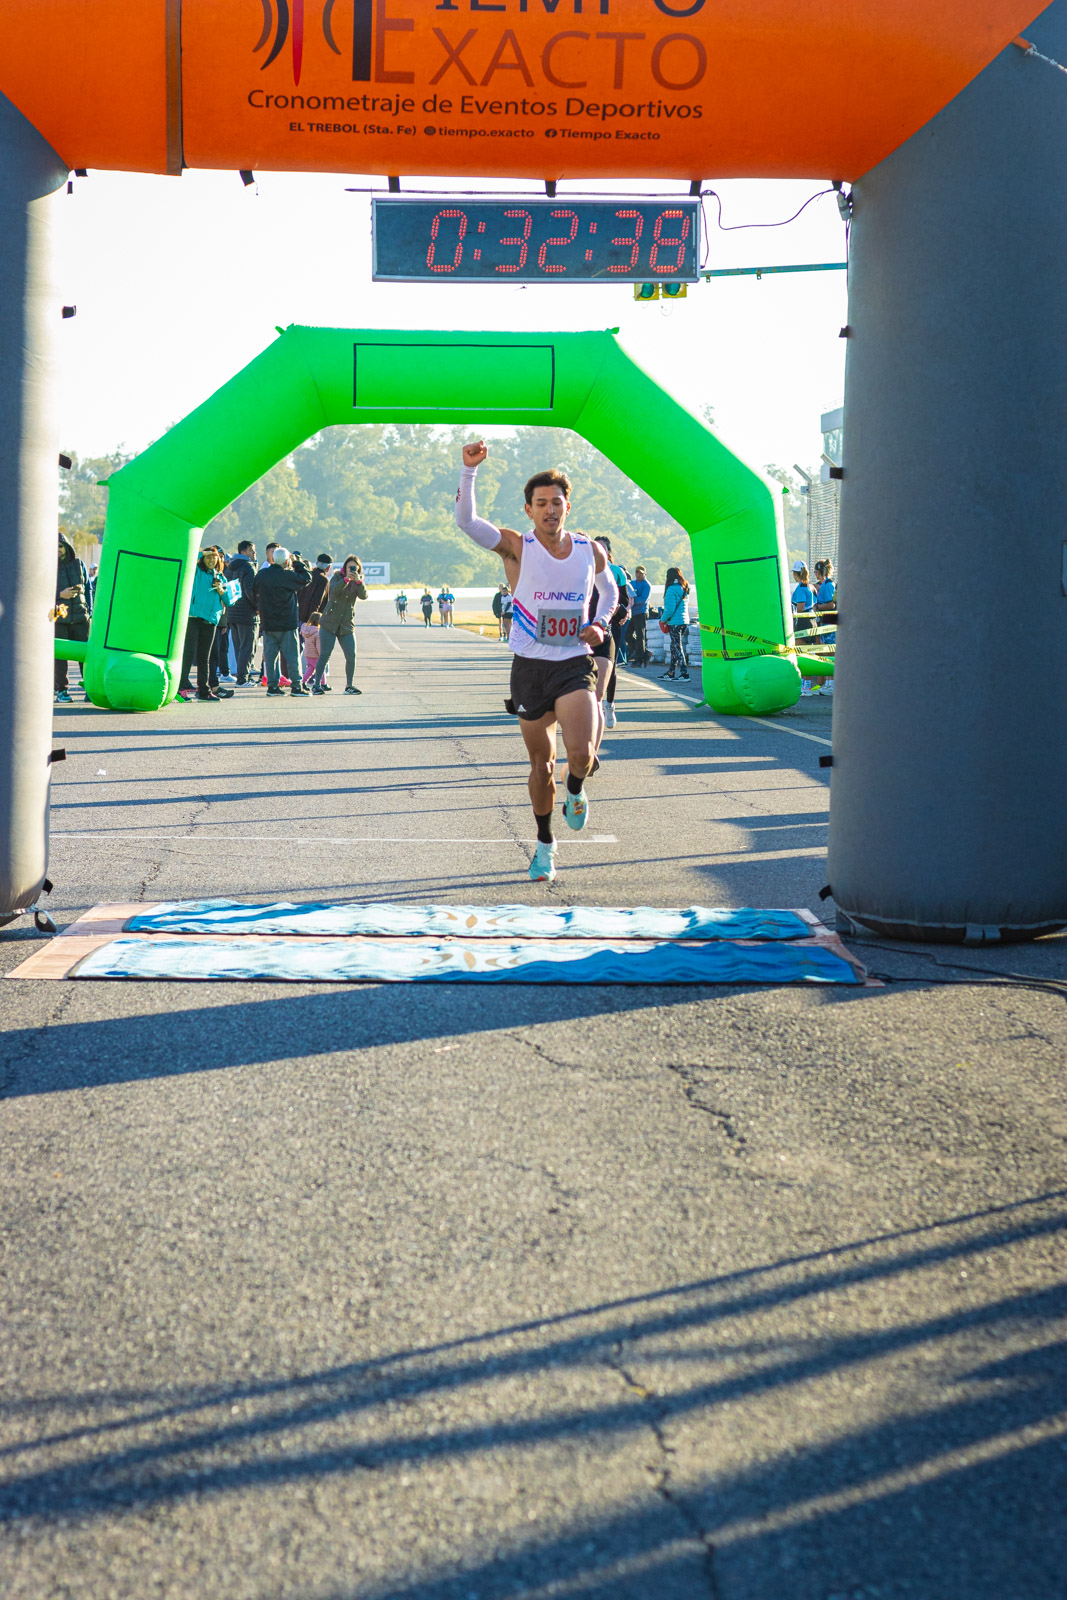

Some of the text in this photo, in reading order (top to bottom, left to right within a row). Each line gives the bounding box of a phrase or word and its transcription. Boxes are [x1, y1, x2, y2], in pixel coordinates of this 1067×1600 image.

[374, 0, 708, 91] EXACTO
[247, 89, 703, 121] Cronometraje de Eventos Deportivos
[289, 122, 417, 136] EL TREBOL (Sta. Fe)
[438, 126, 535, 138] tiempo.exacto
[559, 128, 661, 141] Tiempo Exacto
[426, 208, 690, 274] 0:32:38
[534, 592, 584, 601] RUNNEA
[547, 618, 577, 637] 303
